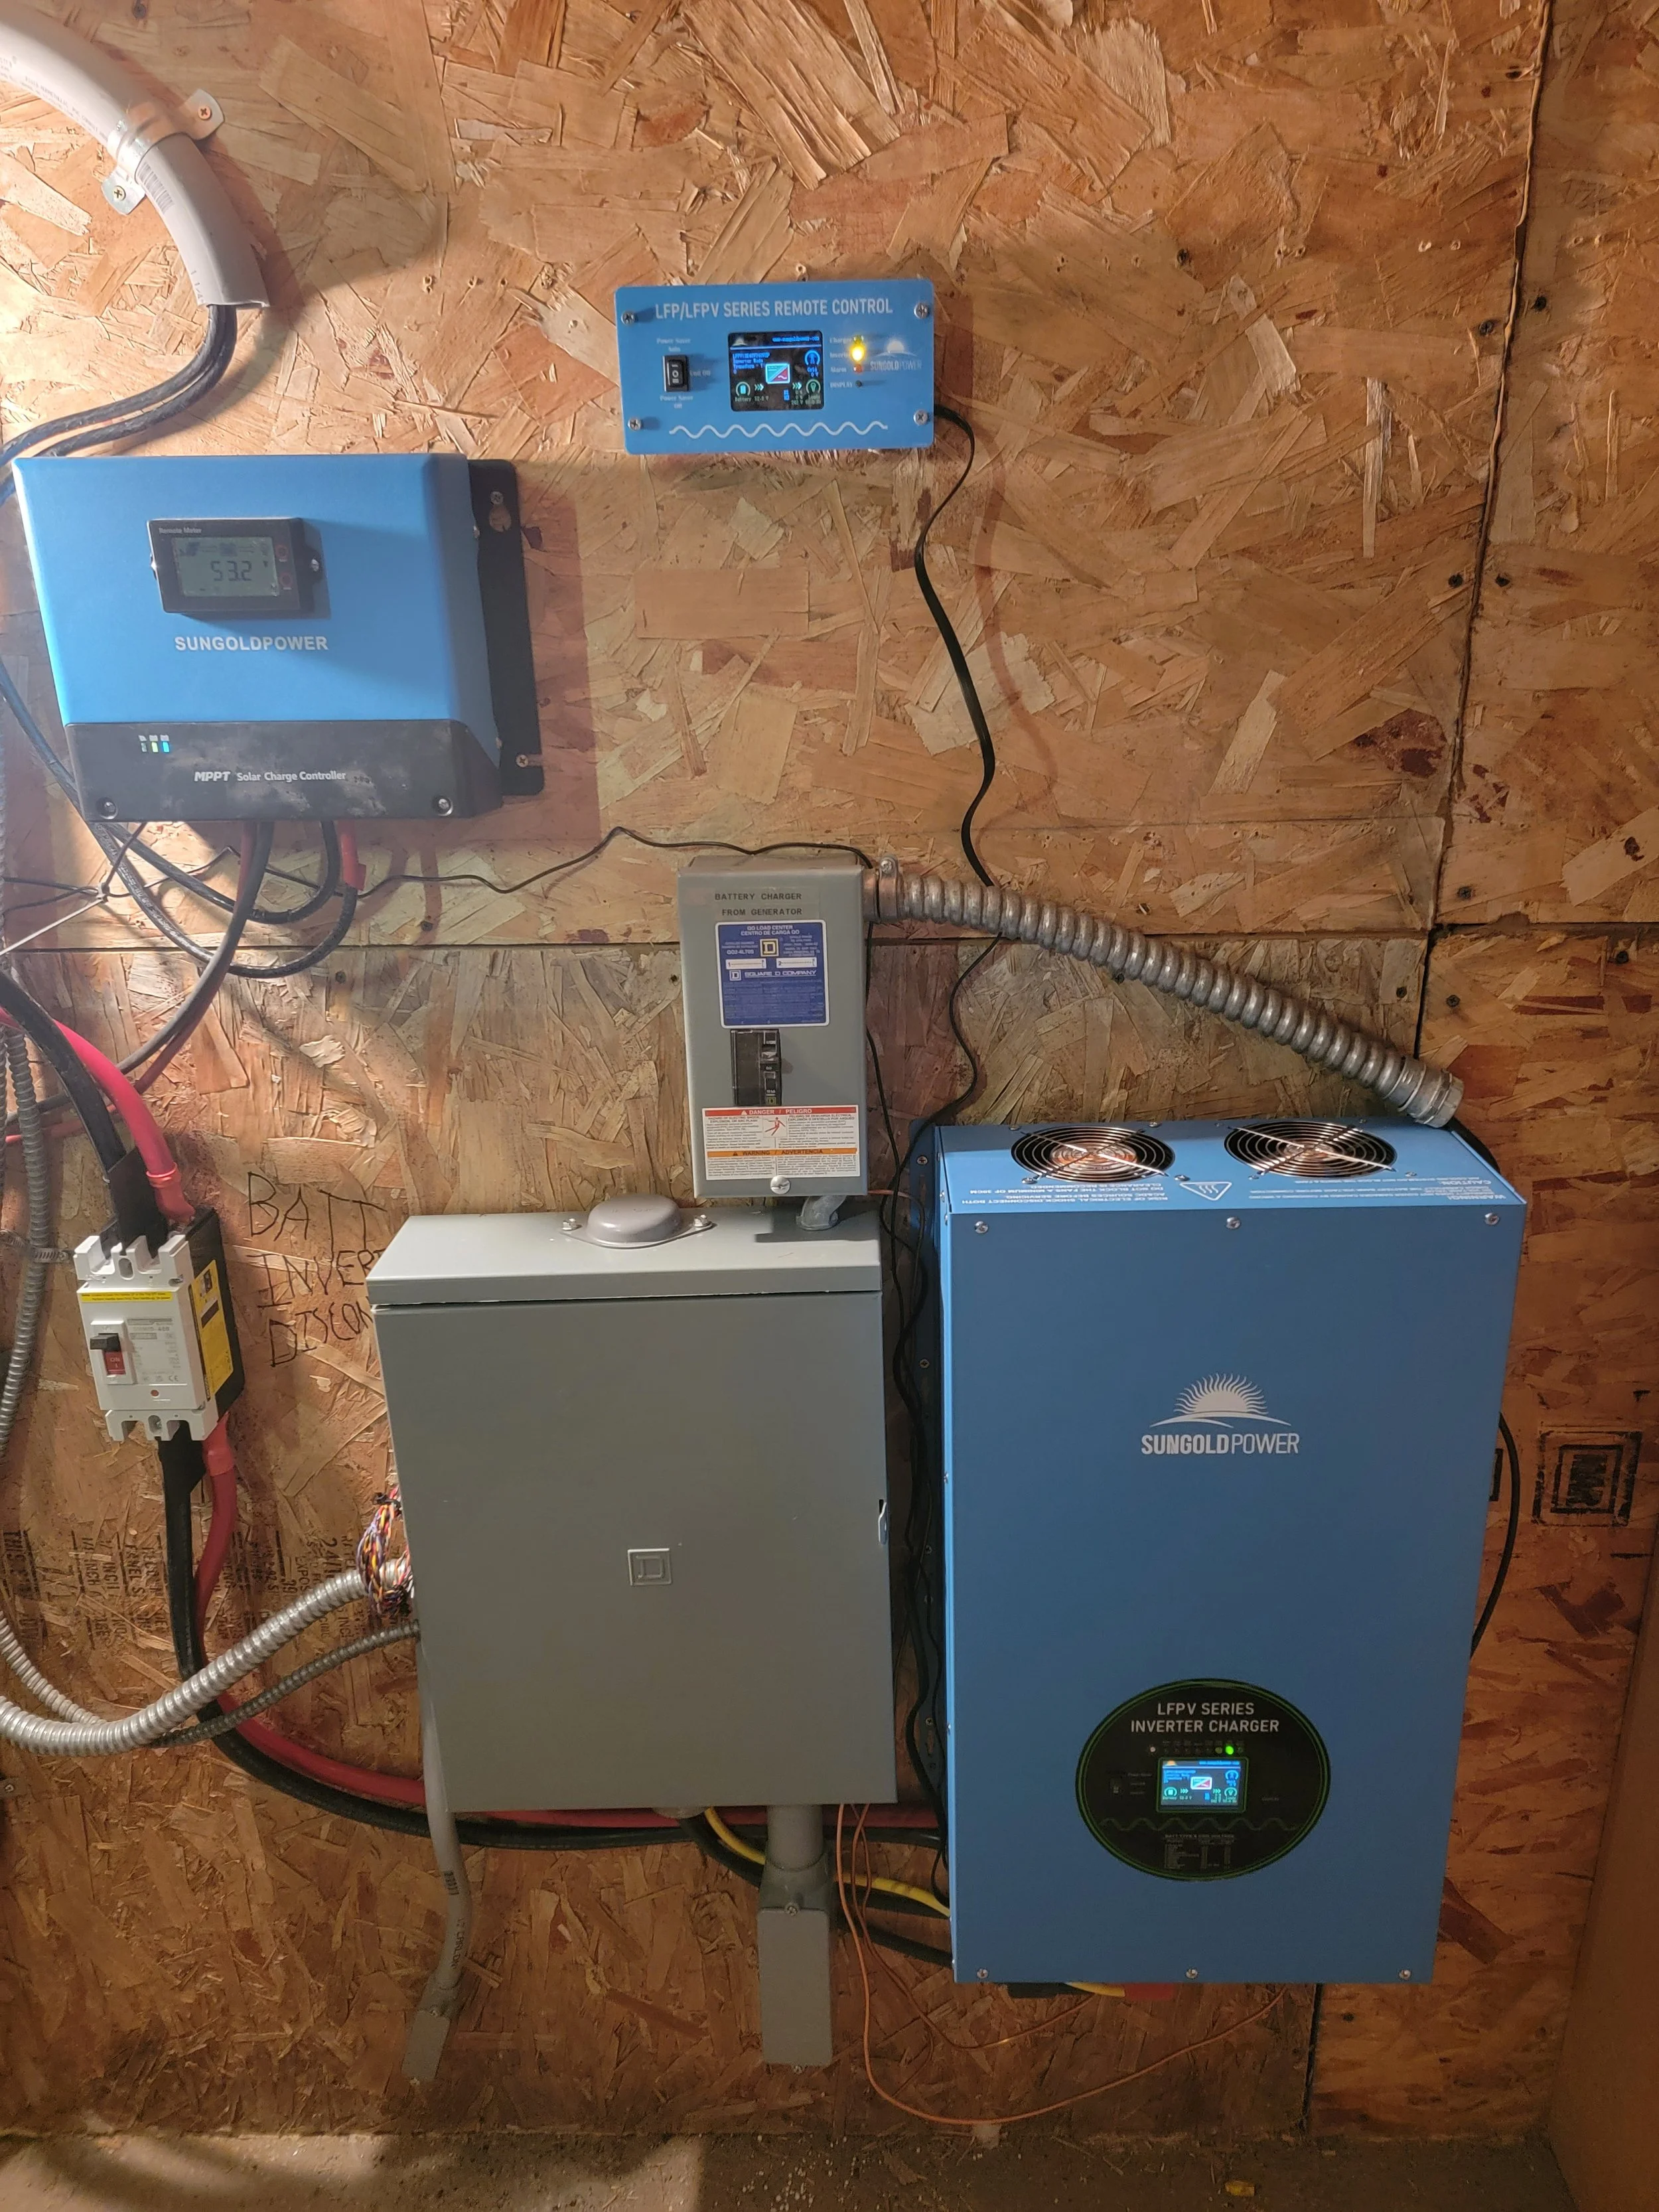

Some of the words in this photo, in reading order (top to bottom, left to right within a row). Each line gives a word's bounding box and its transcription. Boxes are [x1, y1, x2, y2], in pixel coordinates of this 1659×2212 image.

[655, 302, 719, 321] LFP/LFPV
[724, 301, 770, 318] SERIES
[774, 299, 828, 317] REMOTE
[831, 297, 893, 315] CONTROL
[869, 360, 922, 372] SUNGOLDPOWER
[175, 635, 328, 652] SUNGOLDPOWER
[194, 771, 231, 782] MPPT
[237, 771, 261, 782] Solar
[264, 771, 298, 783] Charge
[299, 770, 346, 781] Controller
[714, 893, 755, 901] BATTERY
[760, 892, 802, 901] CHARGER
[751, 907, 803, 916] GENERATOR
[248, 1171, 388, 1262] BATT
[1141, 1432, 1300, 1455] SUNGOLDPOWER
[1157, 1702, 1196, 1716] LFPV
[1201, 1702, 1255, 1716] SERIES
[1130, 1720, 1204, 1733] INVERTER
[1208, 1720, 1279, 1733] CHARGER
